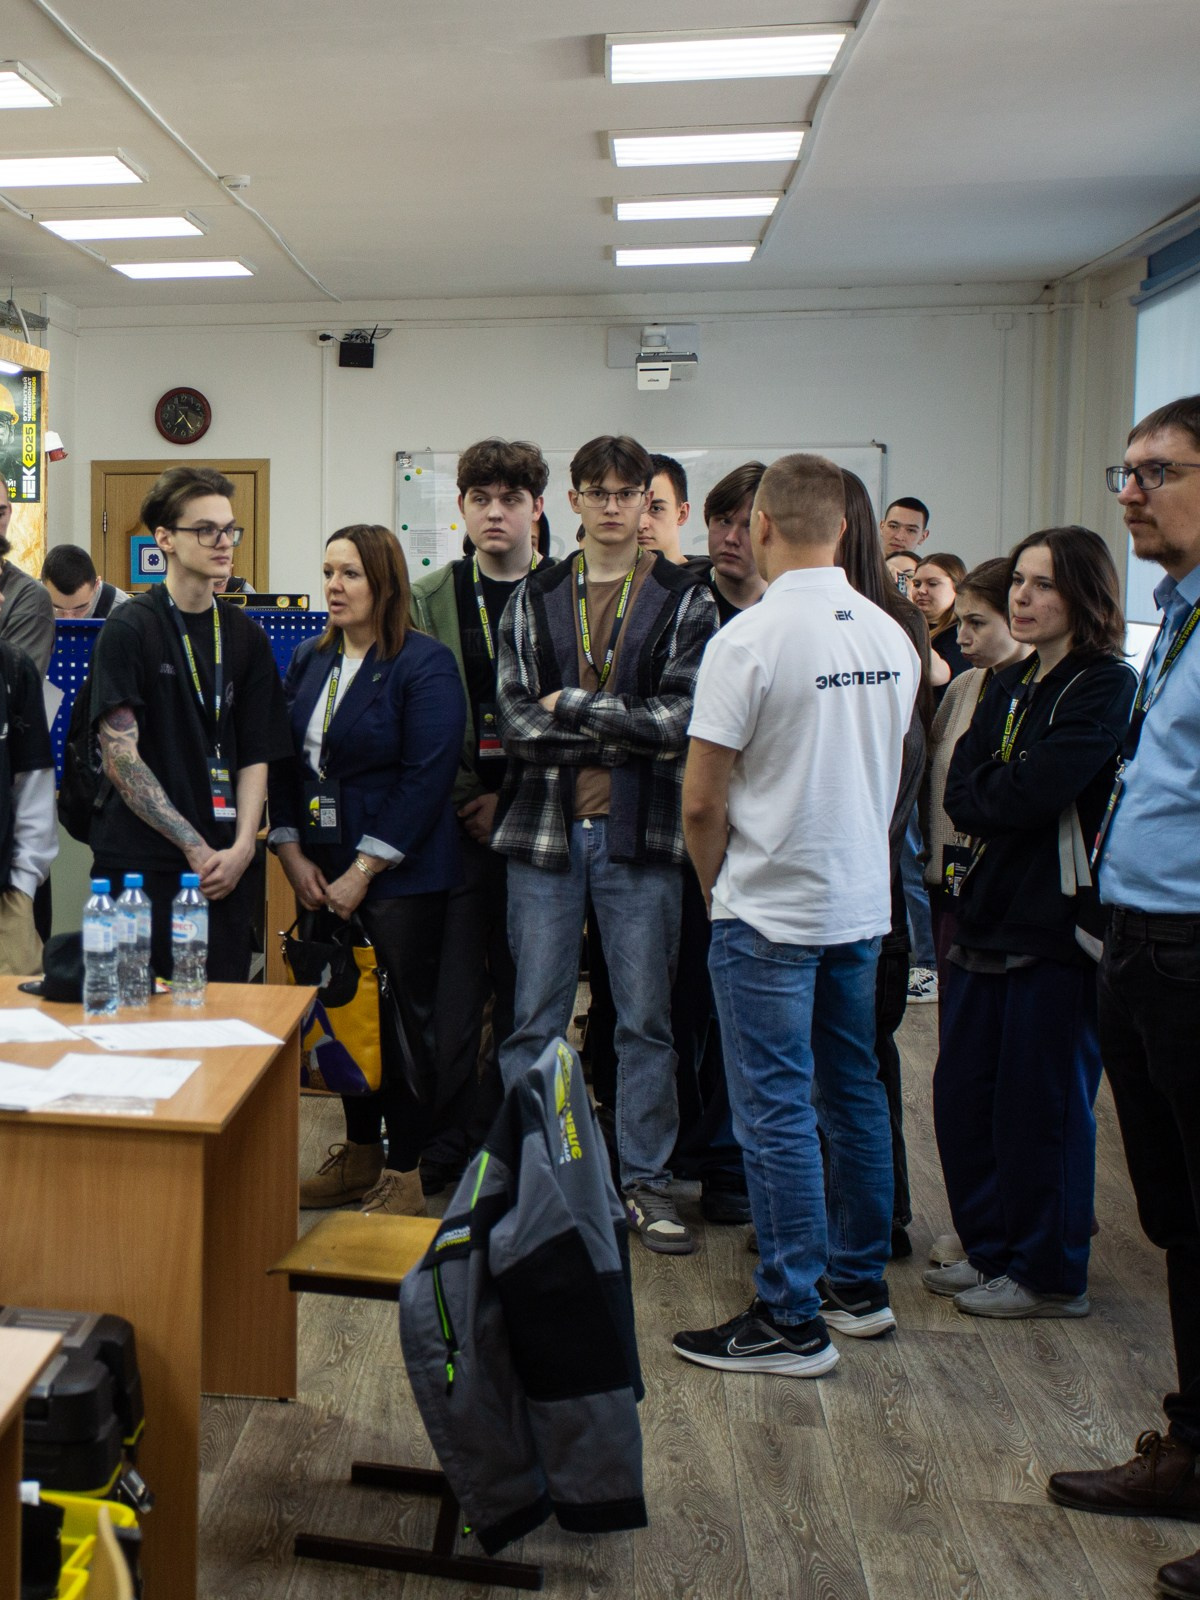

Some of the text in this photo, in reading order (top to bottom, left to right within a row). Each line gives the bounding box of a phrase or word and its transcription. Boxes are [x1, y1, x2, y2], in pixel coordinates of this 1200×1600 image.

[22, 426, 36, 498] IEK 2025
[834, 610, 854, 621] IEK
[1171, 608, 1200, 658] ЭЛЕКТРИКОВ
[815, 671, 901, 690] ЭКСПЕРТ
